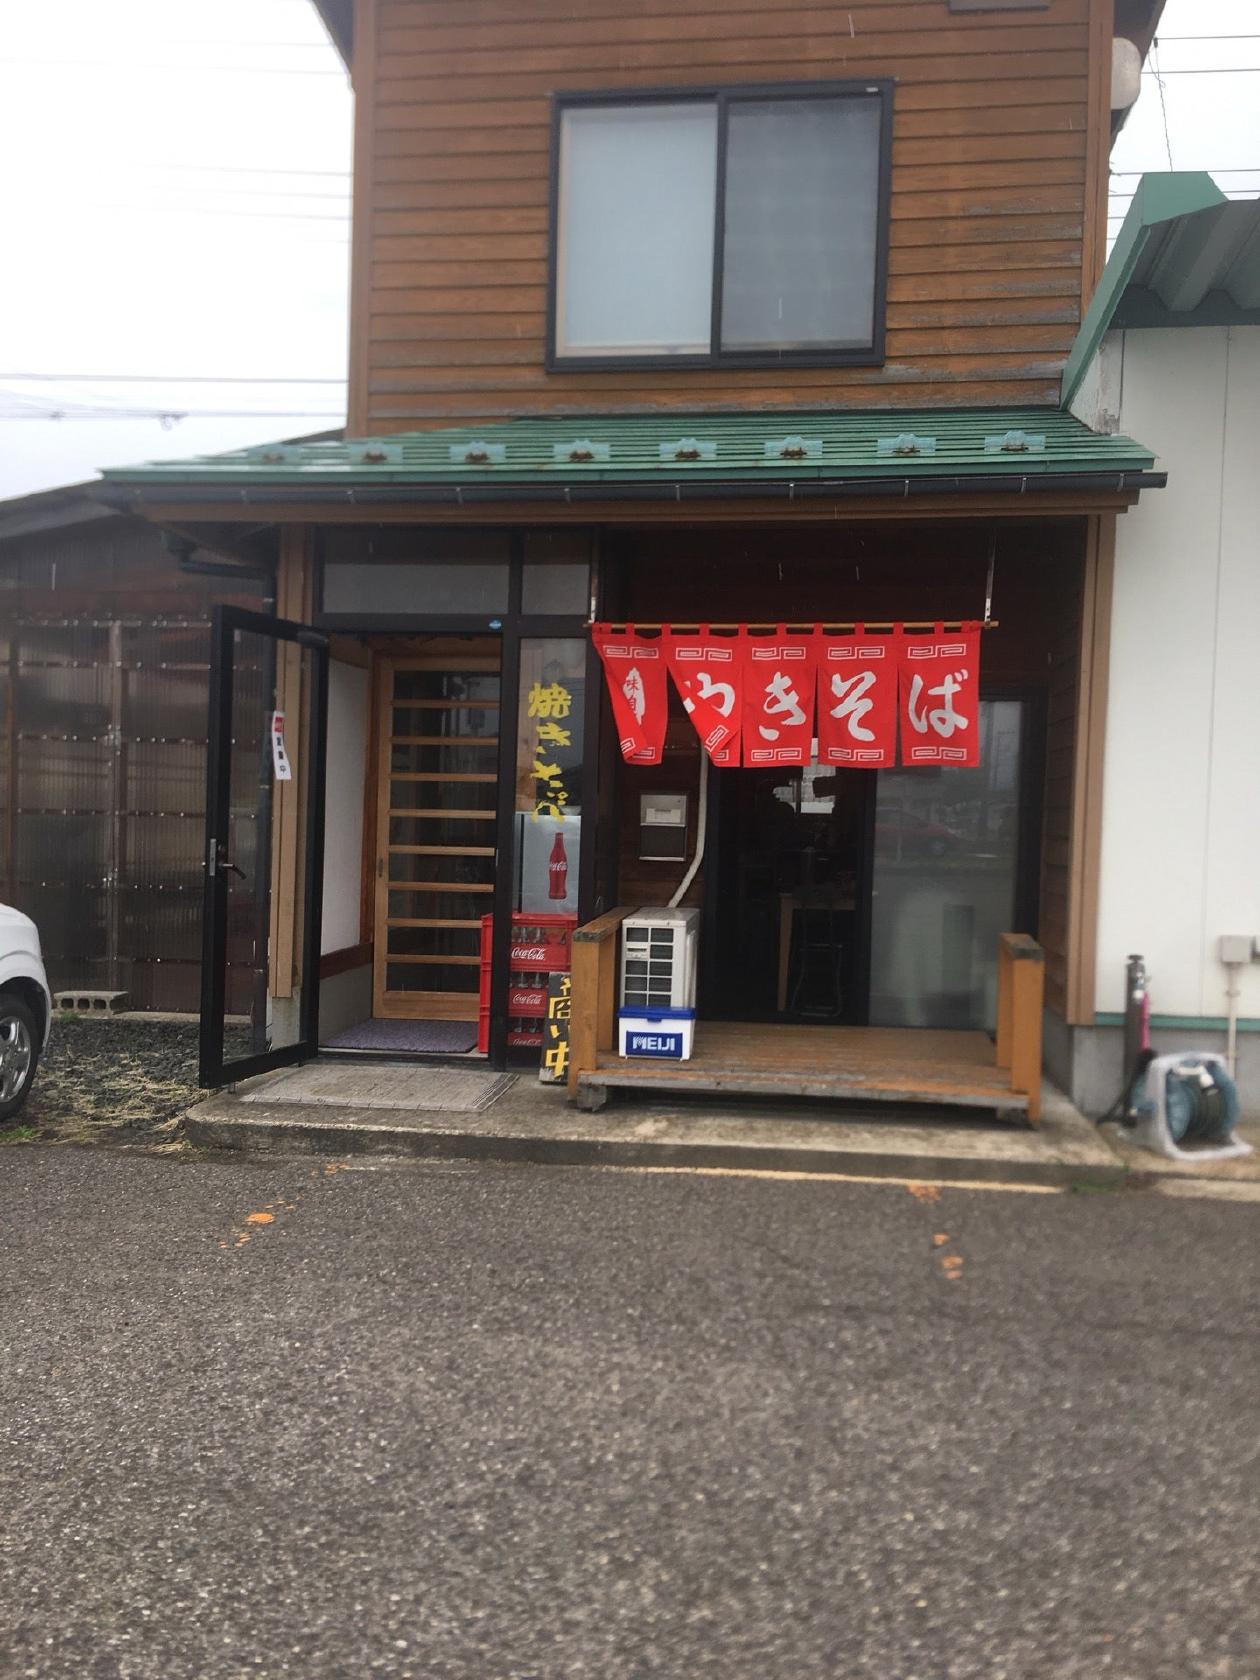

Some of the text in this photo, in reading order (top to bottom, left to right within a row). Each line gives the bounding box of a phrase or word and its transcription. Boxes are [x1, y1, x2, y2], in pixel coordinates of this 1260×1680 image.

[511, 947, 546, 961] Coca-Cola
[512, 993, 542, 1005] Coca-Cola
[632, 1036, 675, 1051] MEIJI
